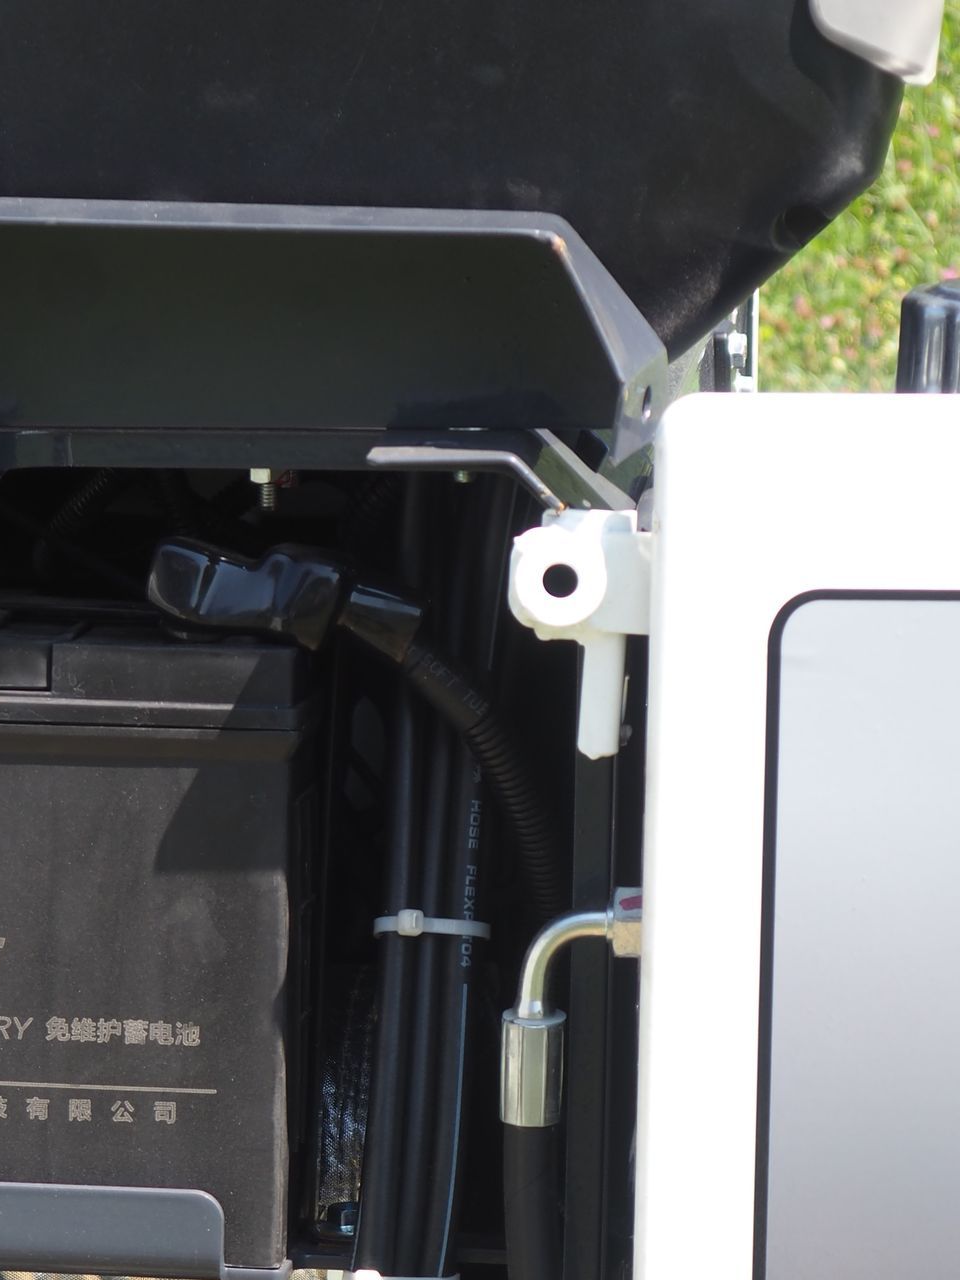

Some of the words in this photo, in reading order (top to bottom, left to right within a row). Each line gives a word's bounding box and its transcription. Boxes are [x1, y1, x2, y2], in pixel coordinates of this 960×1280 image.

[468, 799, 482, 849] HOSE
[45, 1016, 201, 1047] 免维护蓄电池
